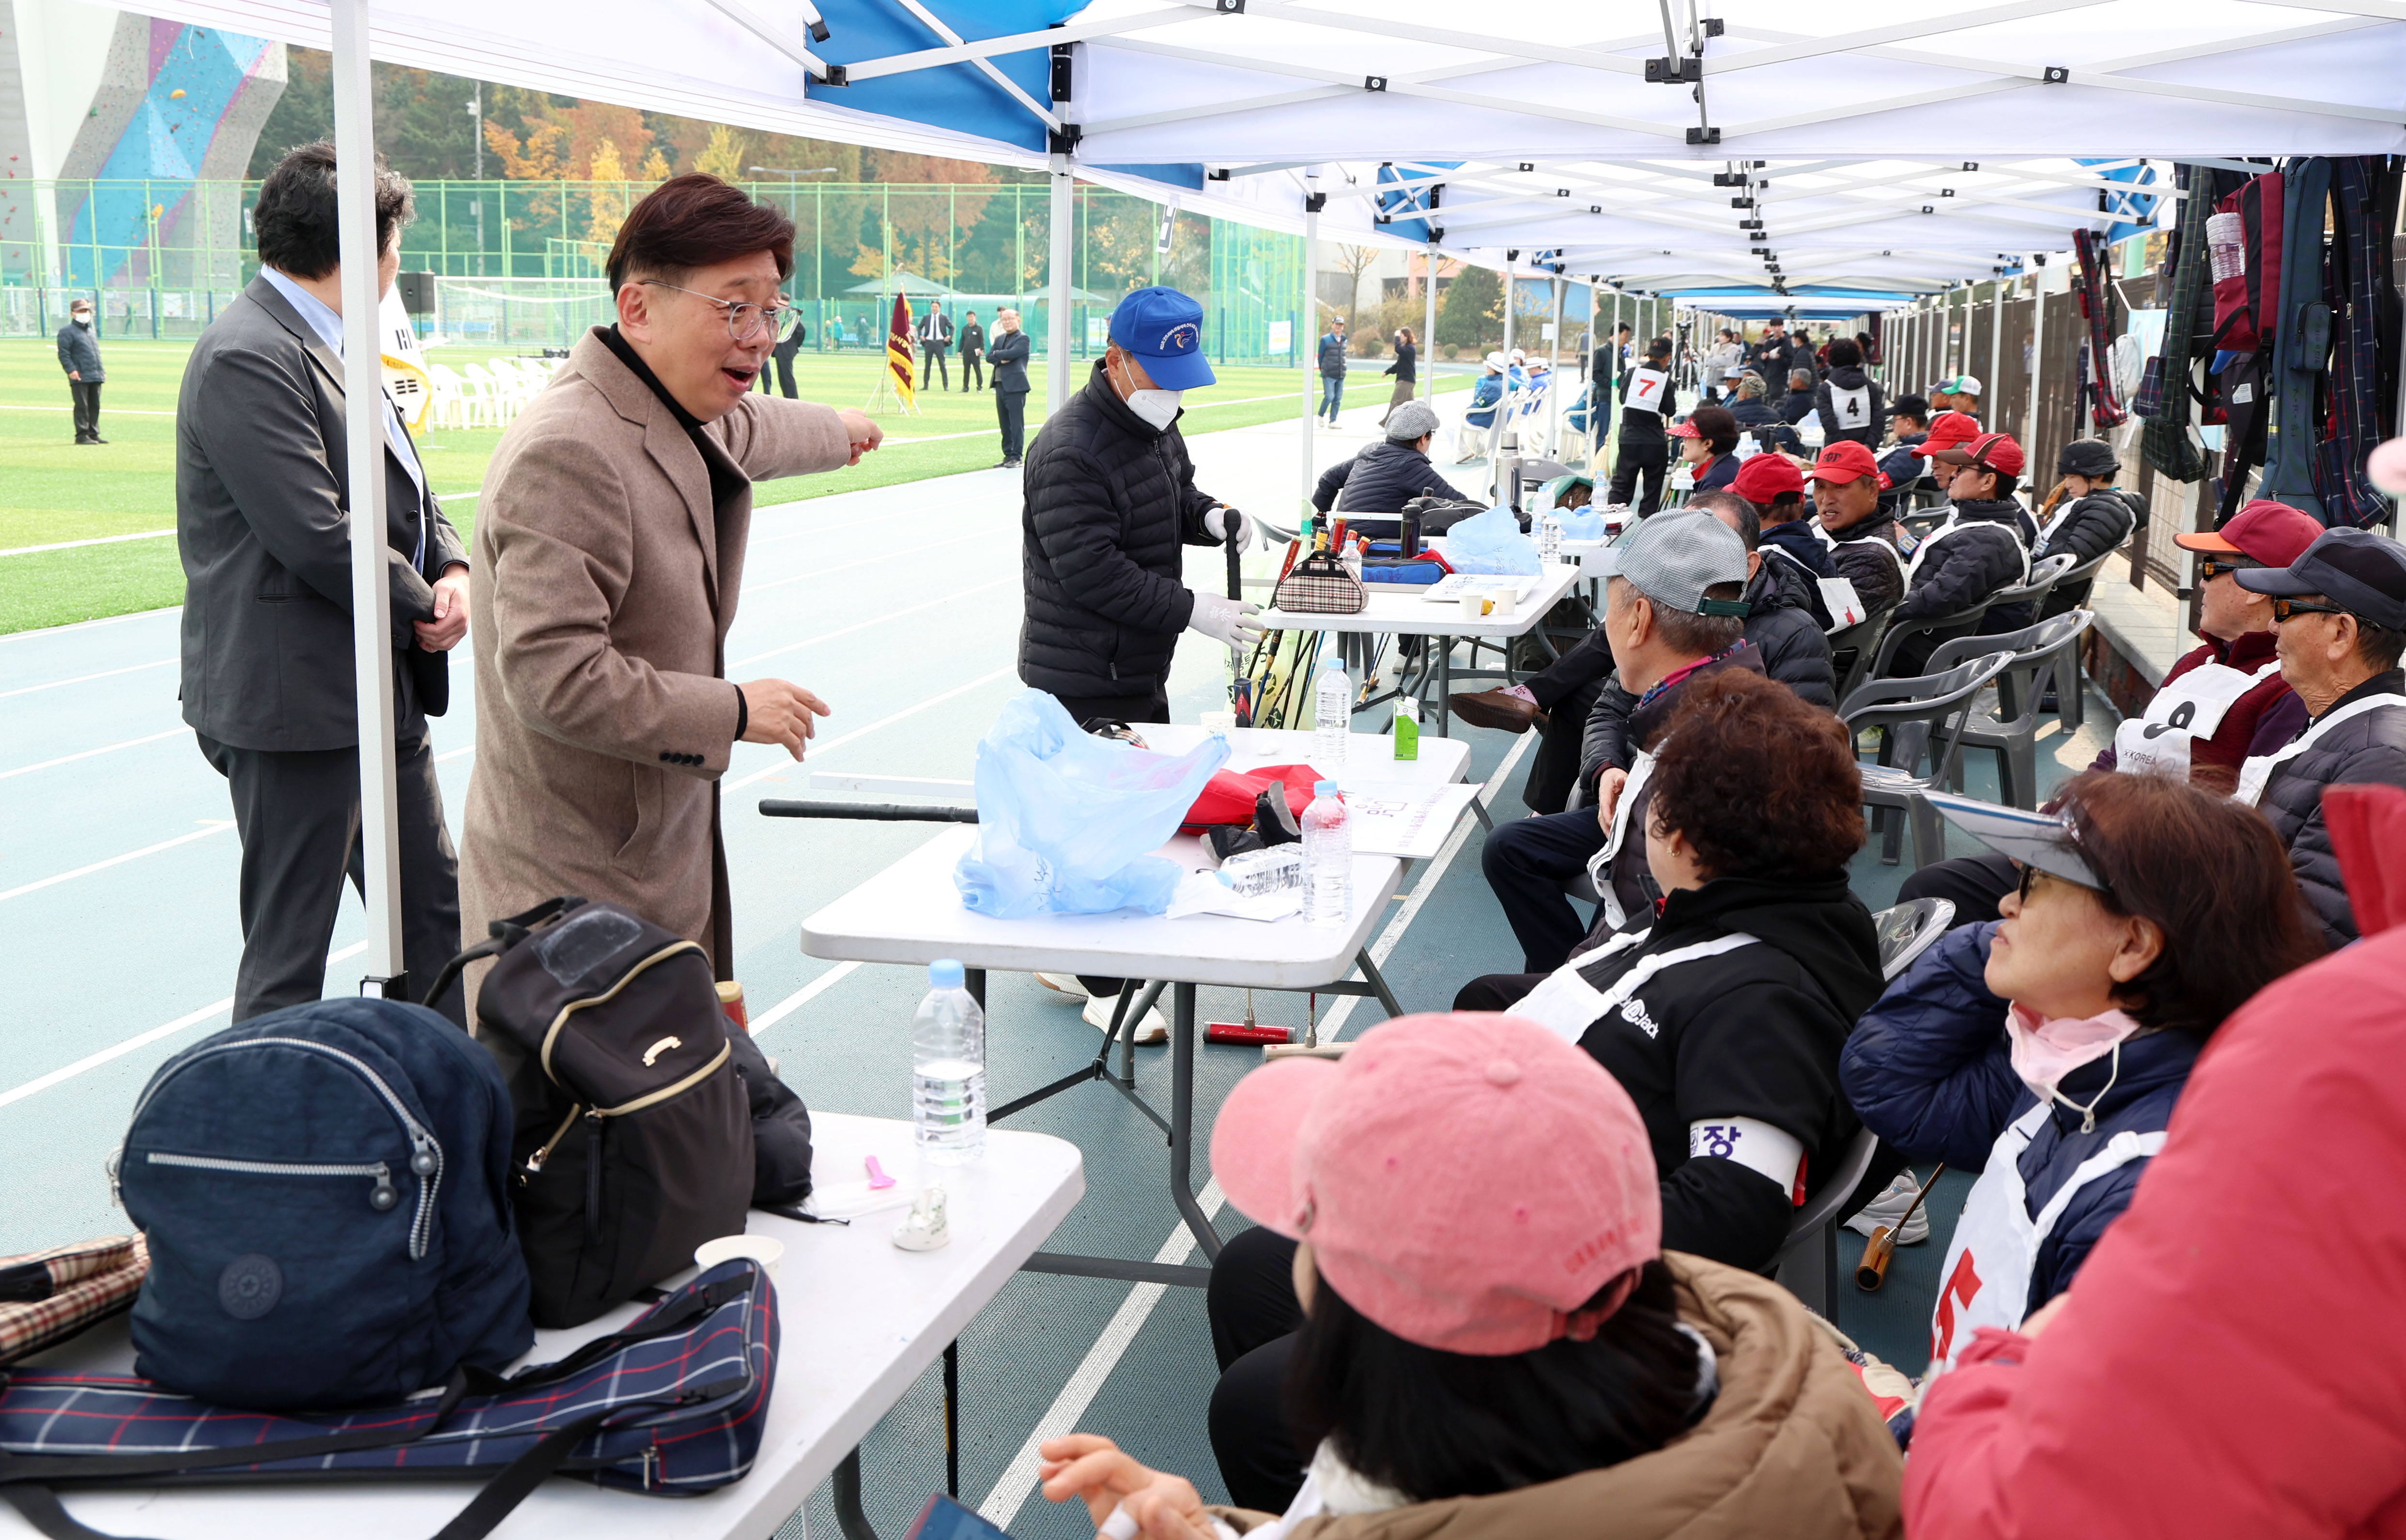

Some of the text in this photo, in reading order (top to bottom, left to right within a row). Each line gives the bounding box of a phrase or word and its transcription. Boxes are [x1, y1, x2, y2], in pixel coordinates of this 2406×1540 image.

[1639, 378, 1656, 397] 7
[1847, 397, 1859, 416] 4
[2128, 751, 2157, 766] KOREA
